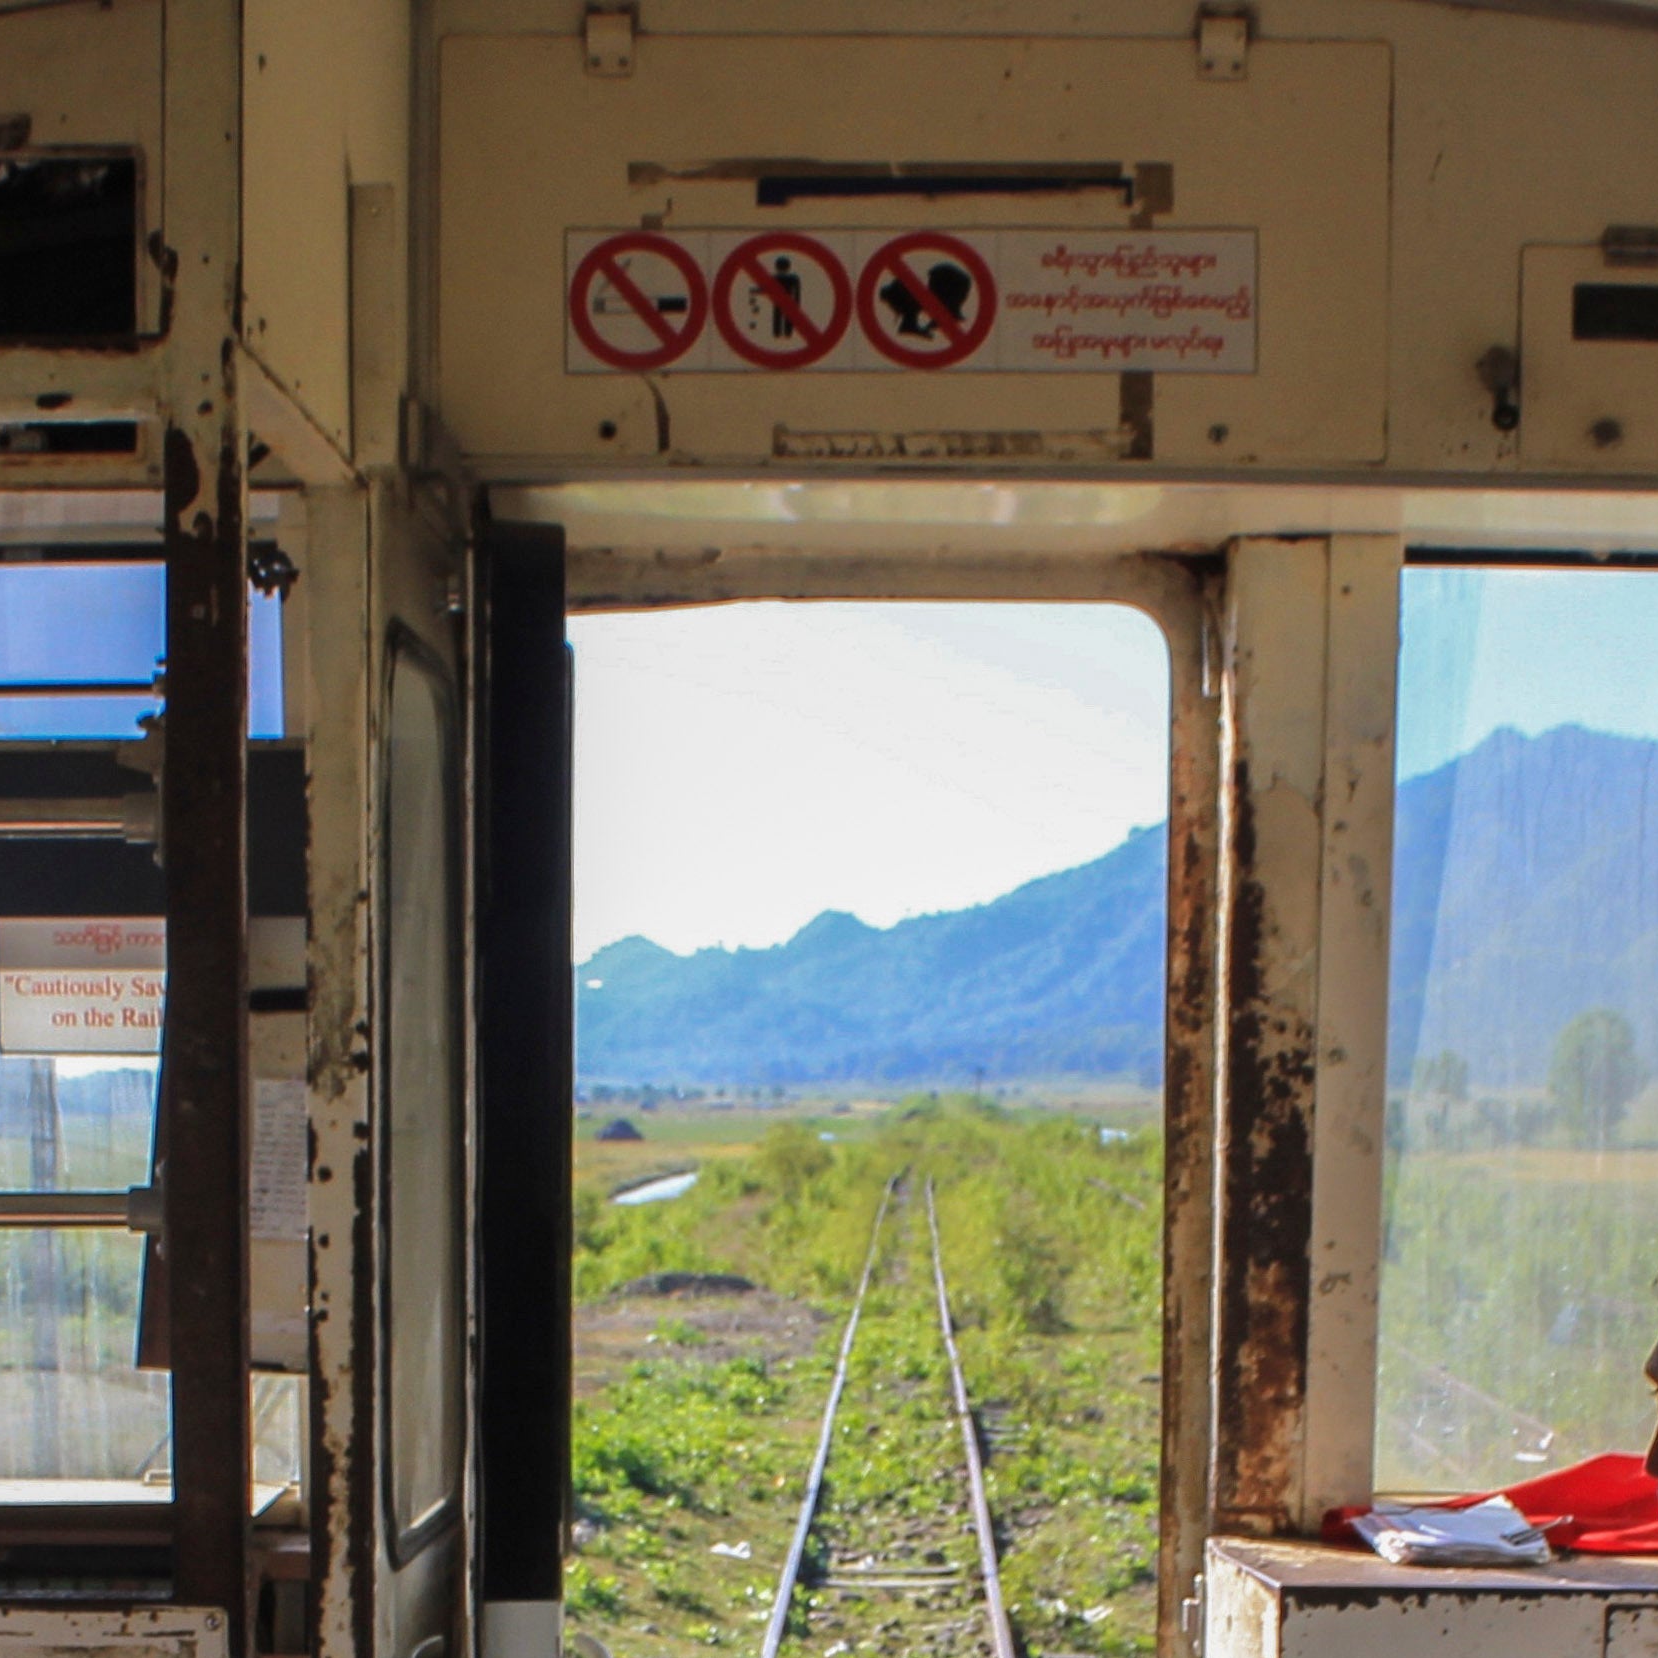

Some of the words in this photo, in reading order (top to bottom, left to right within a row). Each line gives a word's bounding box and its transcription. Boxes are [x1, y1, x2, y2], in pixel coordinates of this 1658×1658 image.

[4, 975, 125, 1001] "Cautiously
[130, 976, 165, 998] Sav
[51, 1011, 78, 1027] on
[84, 1007, 115, 1028] the
[121, 1006, 163, 1028] Rail
